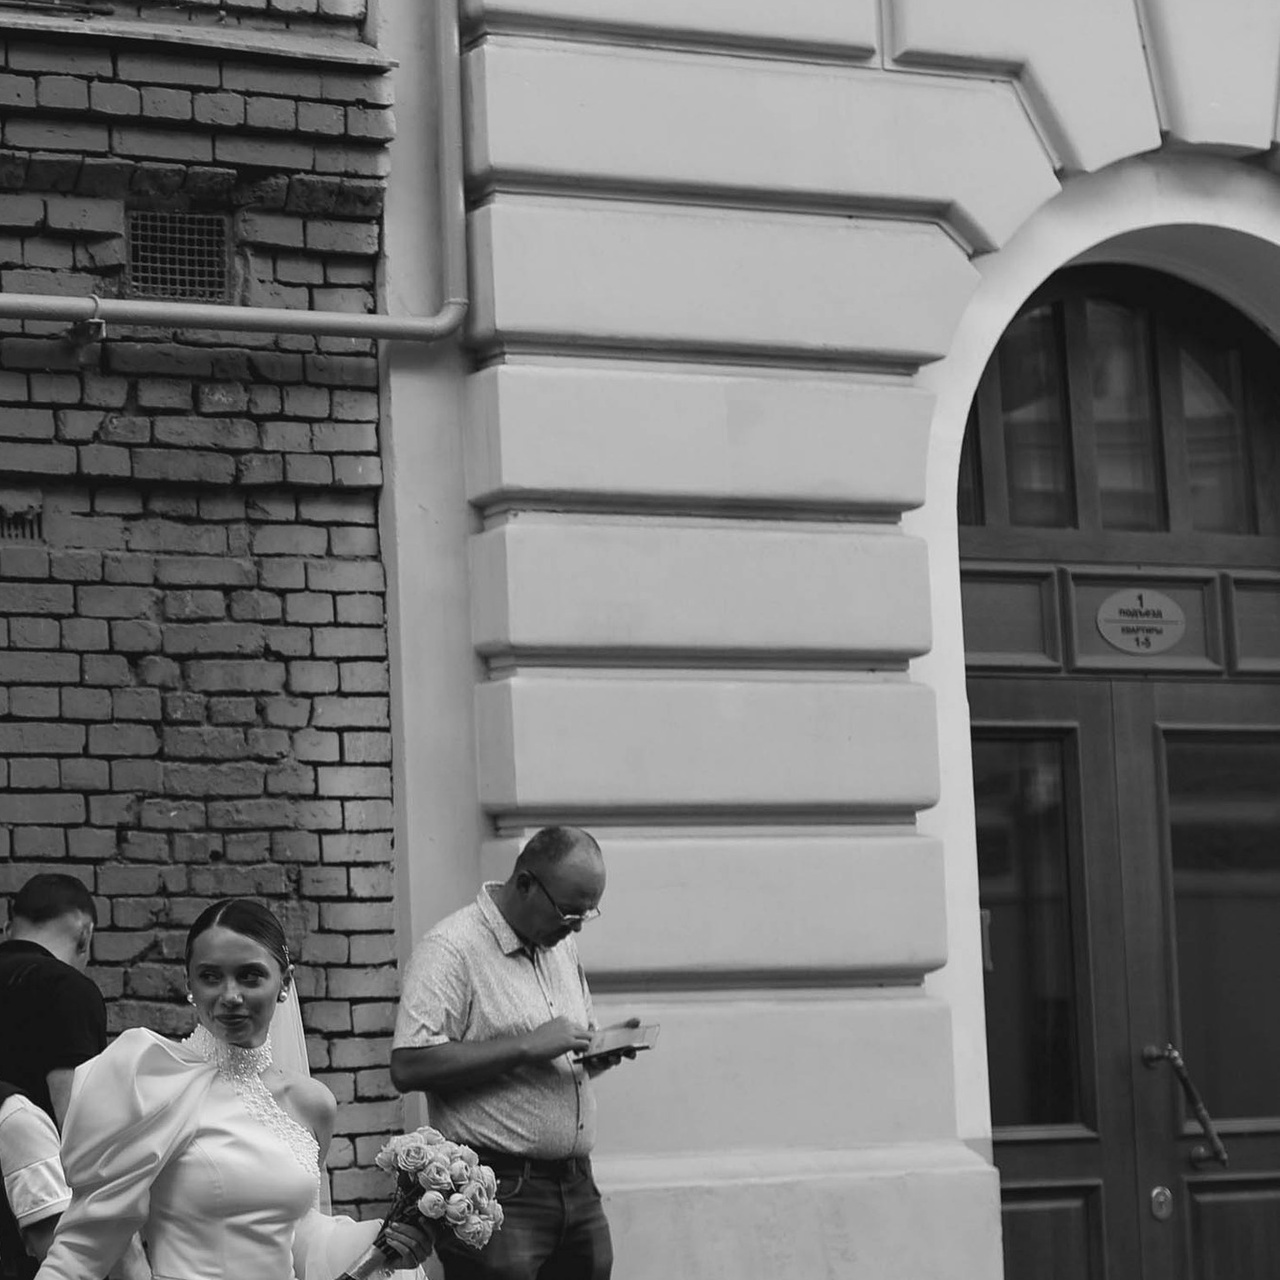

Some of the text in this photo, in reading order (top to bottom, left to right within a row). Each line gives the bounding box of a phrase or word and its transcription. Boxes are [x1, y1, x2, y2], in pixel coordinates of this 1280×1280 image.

[1136, 593, 1144, 608] 1
[1118, 608, 1163, 619] ПОДЪЕЗД
[1121, 626, 1164, 635] КВАРТИРЫ
